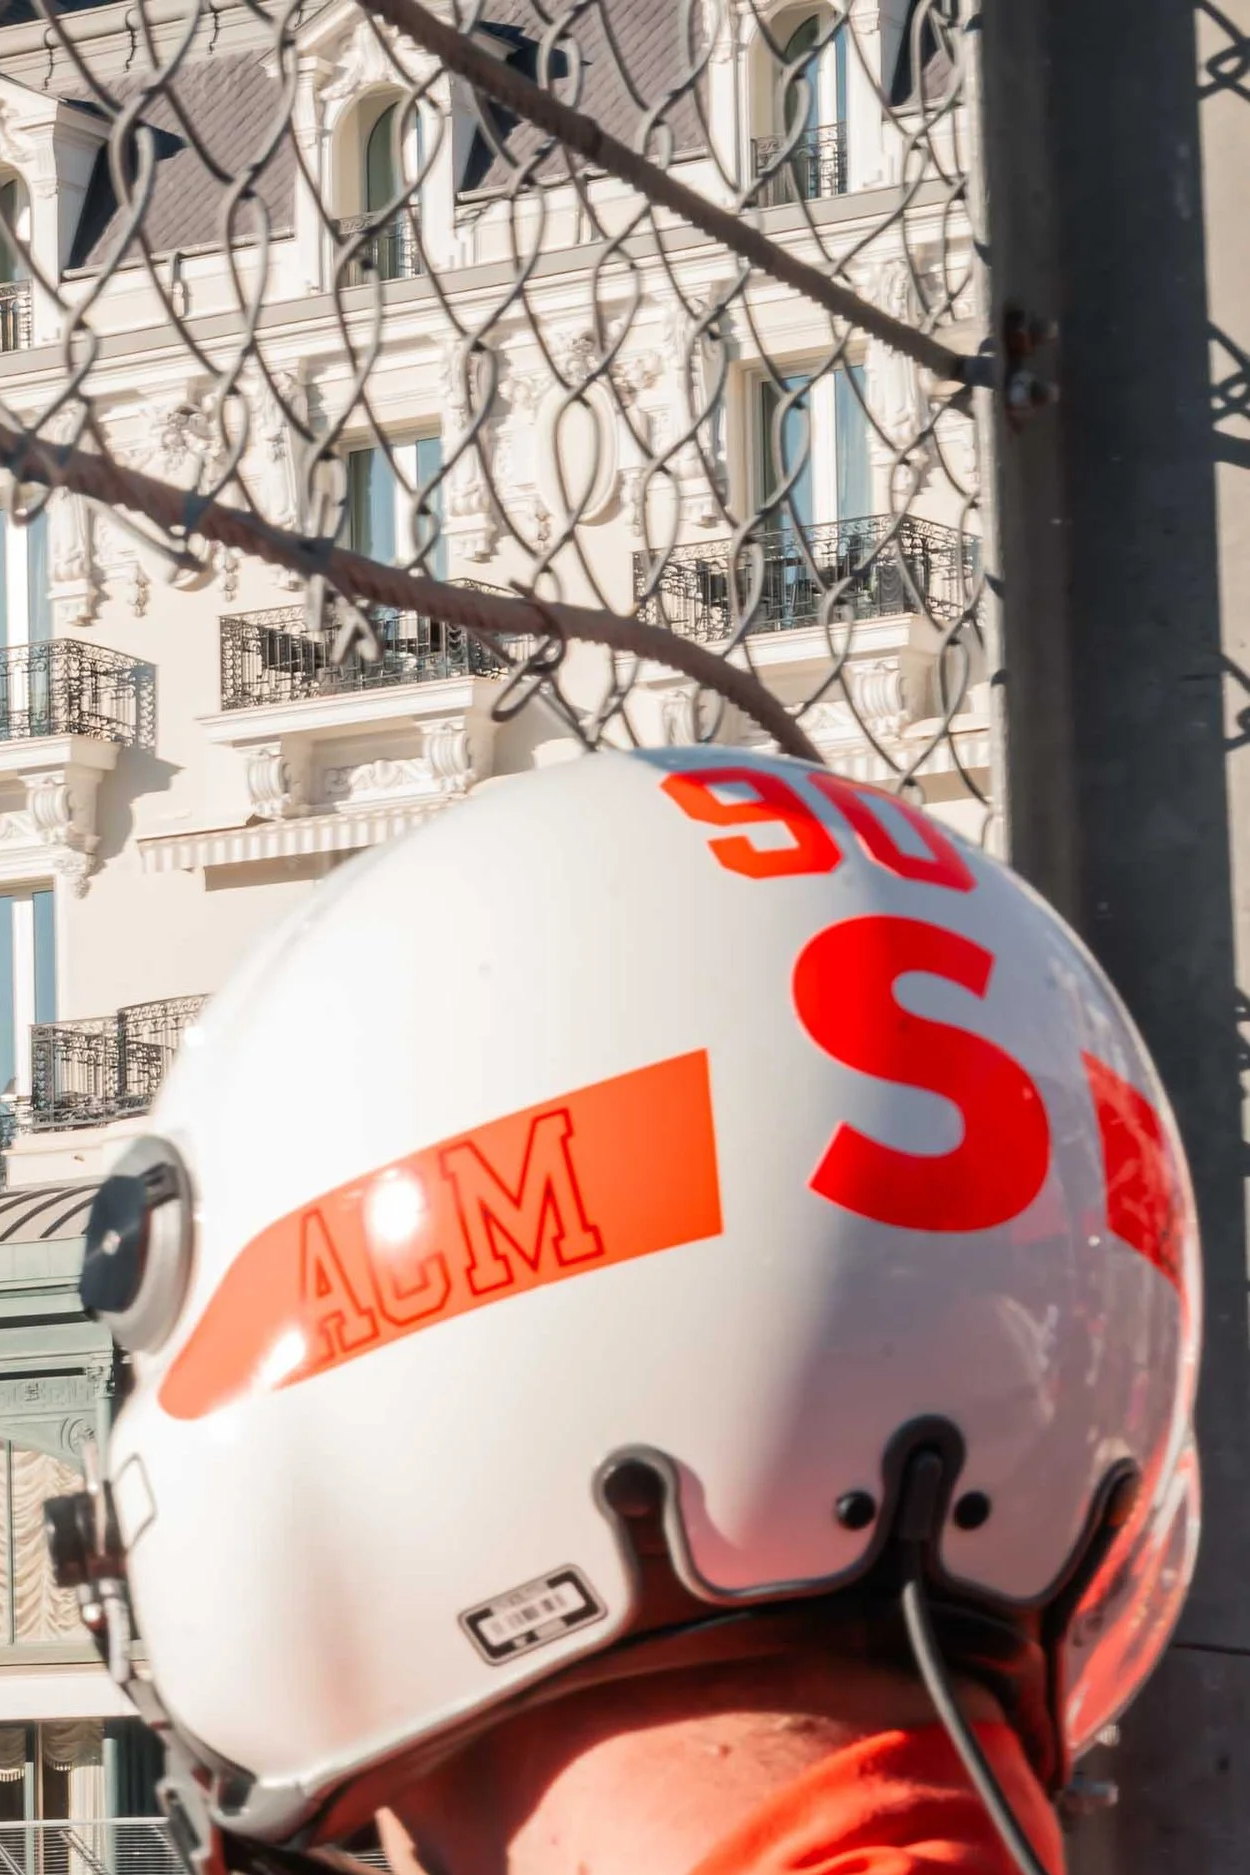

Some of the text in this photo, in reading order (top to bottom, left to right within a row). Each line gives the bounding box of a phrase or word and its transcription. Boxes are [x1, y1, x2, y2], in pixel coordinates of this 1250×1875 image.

[659, 766, 978, 894] 90
[791, 913, 1050, 1234] S
[299, 1106, 605, 1367] ACM
